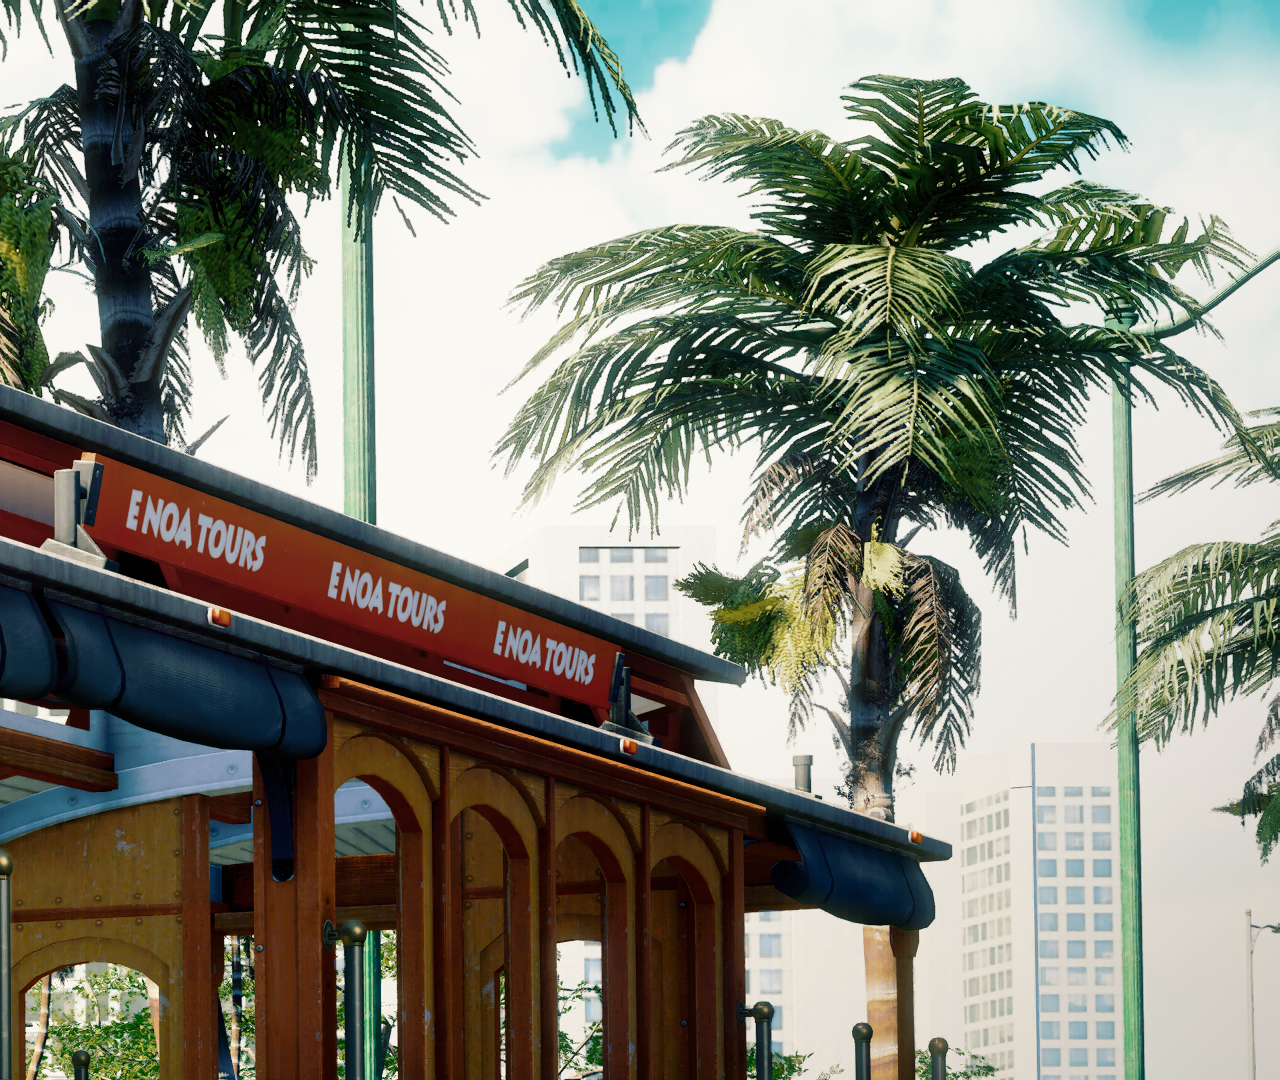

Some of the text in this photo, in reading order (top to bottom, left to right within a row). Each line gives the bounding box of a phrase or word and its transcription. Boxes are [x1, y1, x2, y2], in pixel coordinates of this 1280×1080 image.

[126, 489, 267, 573] E NOA TOURS
[327, 561, 446, 635] E NOA TOURS
[493, 620, 596, 686] E NOA TOURS
